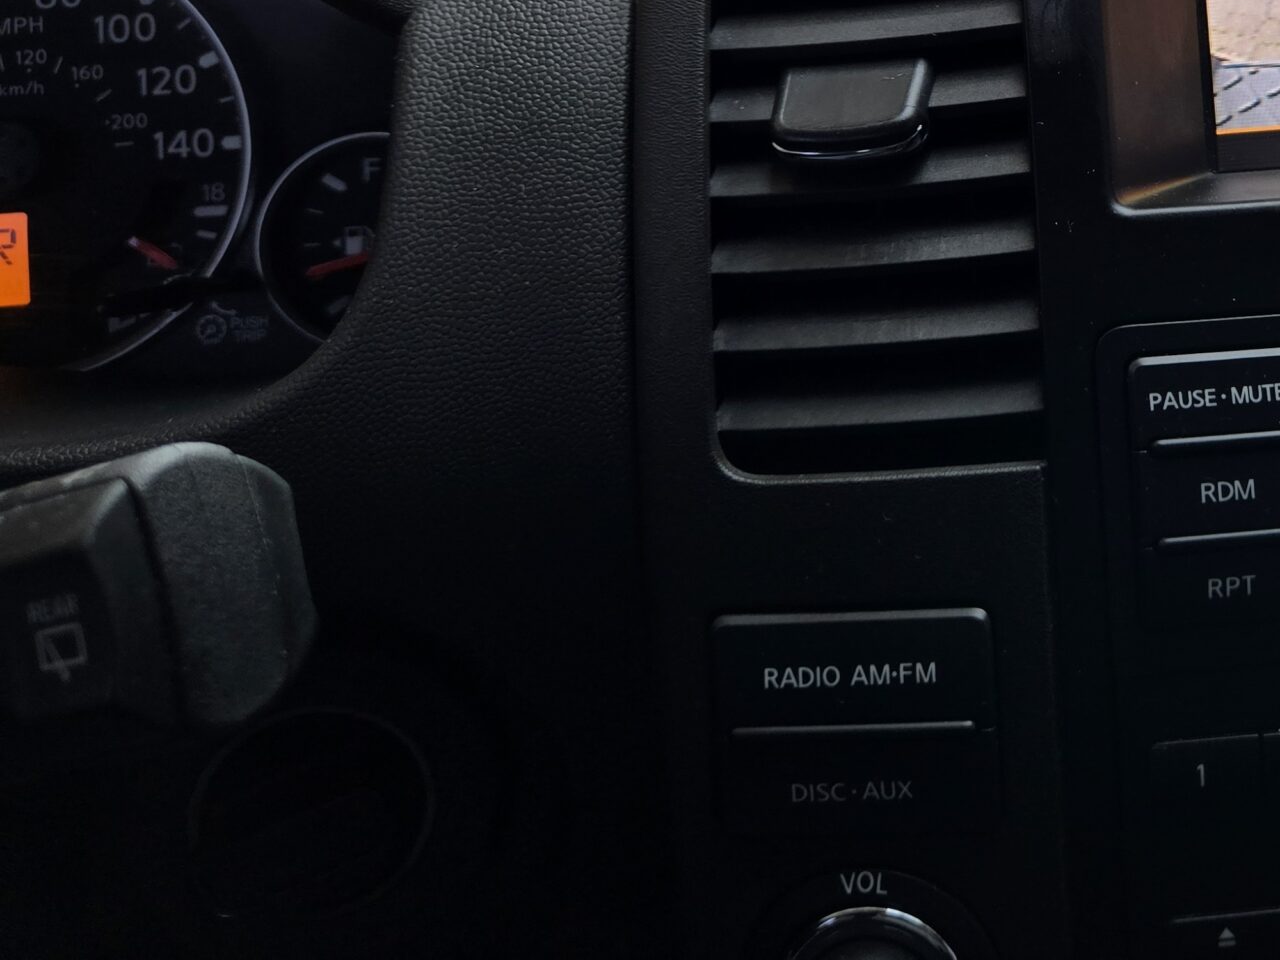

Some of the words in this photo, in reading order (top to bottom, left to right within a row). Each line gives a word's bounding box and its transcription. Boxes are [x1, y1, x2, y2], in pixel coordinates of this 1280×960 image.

[94, 12, 156, 44] 100
[15, 48, 48, 66] 120
[71, 64, 104, 81] 160
[136, 64, 197, 97] 120
[111, 112, 148, 130] 200
[152, 128, 215, 160] 140
[1200, 478, 1256, 504] RDM
[1207, 575, 1256, 600] RPT
[763, 665, 841, 689] RADIO
[1196, 763, 1206, 787] 1
[840, 870, 888, 895] VOL
